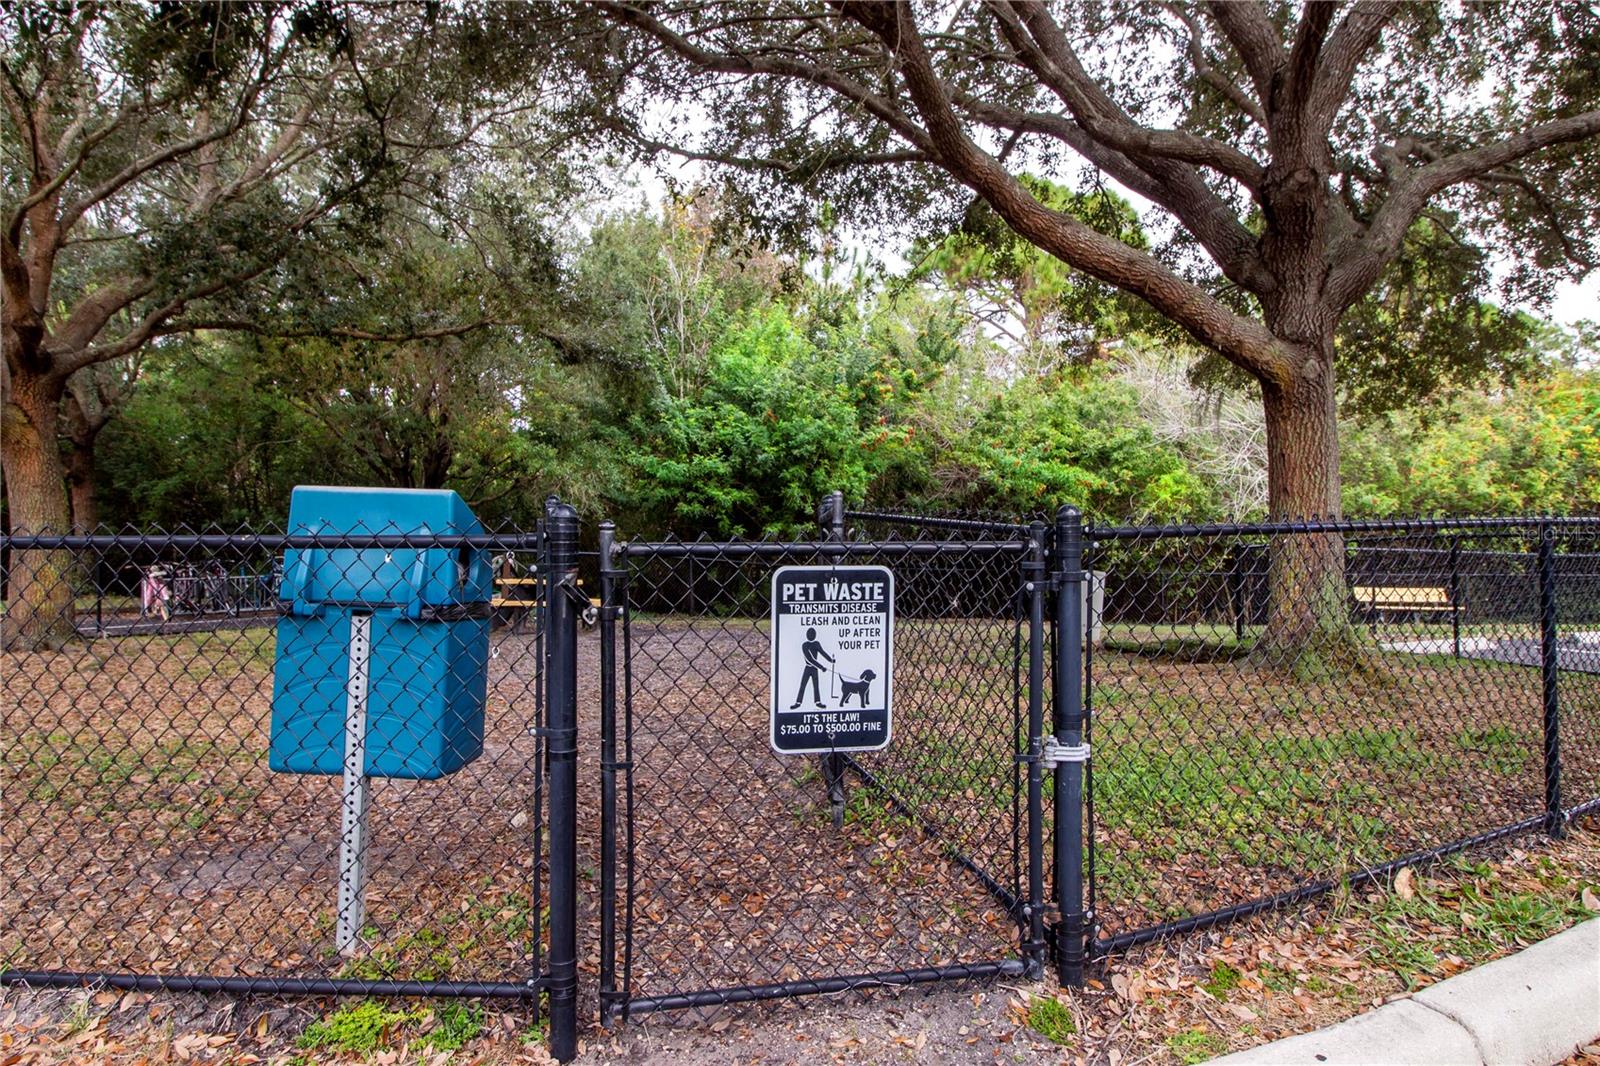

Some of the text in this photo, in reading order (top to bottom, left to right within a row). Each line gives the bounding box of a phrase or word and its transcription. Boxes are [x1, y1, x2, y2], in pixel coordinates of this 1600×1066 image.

[782, 582, 884, 601] PET WASTE
[789, 603, 877, 614] TRANSMITS DISEASE
[801, 615, 881, 626] LEASH AND CLEAN
[839, 628, 881, 638] UP AFTER
[838, 640, 881, 650] YOUR PET
[803, 713, 860, 723] IT'S THE LAW!
[780, 722, 882, 735] $75.00 TO $500.00 FINE
